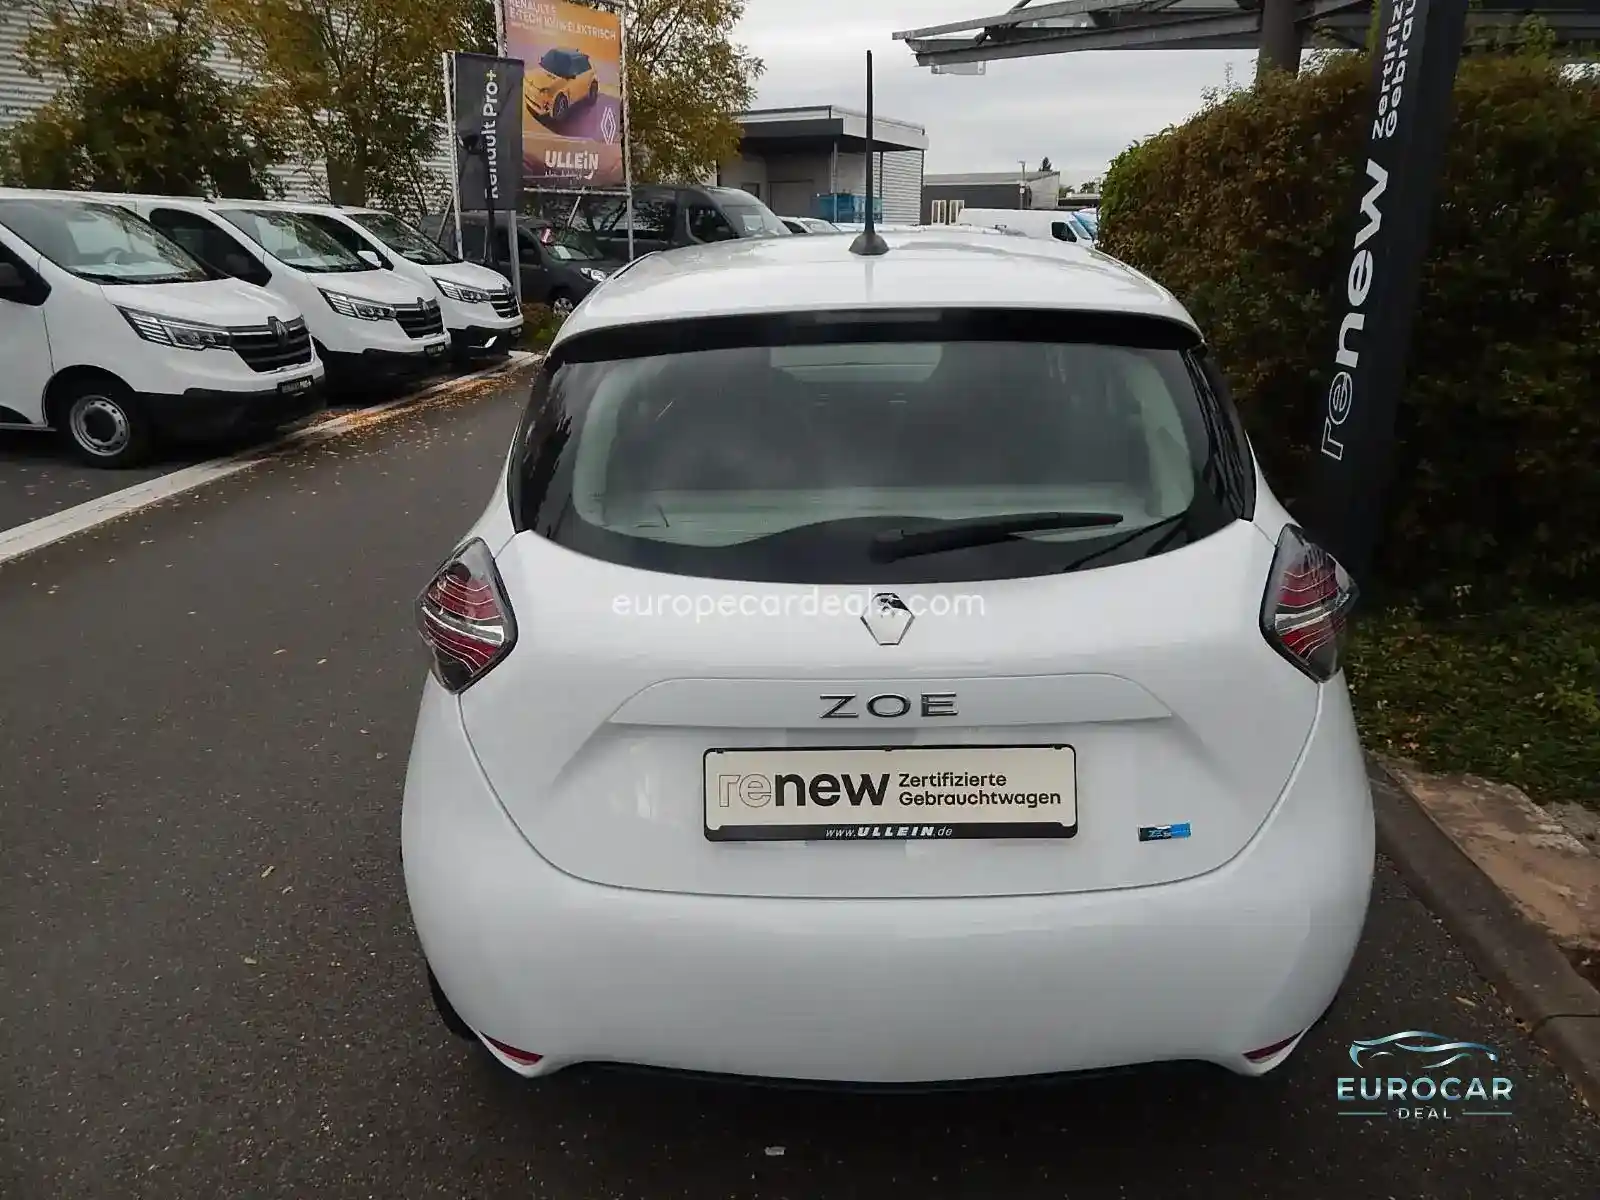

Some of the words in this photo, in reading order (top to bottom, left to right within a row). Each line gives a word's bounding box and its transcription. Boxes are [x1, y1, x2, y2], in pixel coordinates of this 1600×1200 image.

[1372, 0, 1404, 140] Zertifiz
[483, 69, 499, 117] Pro+
[1320, 158, 1389, 461] renew
[820, 692, 960, 719] ZOE
[719, 773, 891, 808] renew
[898, 771, 1007, 788] Zertifizierte
[899, 789, 1062, 808] Gebrauchtwagen
